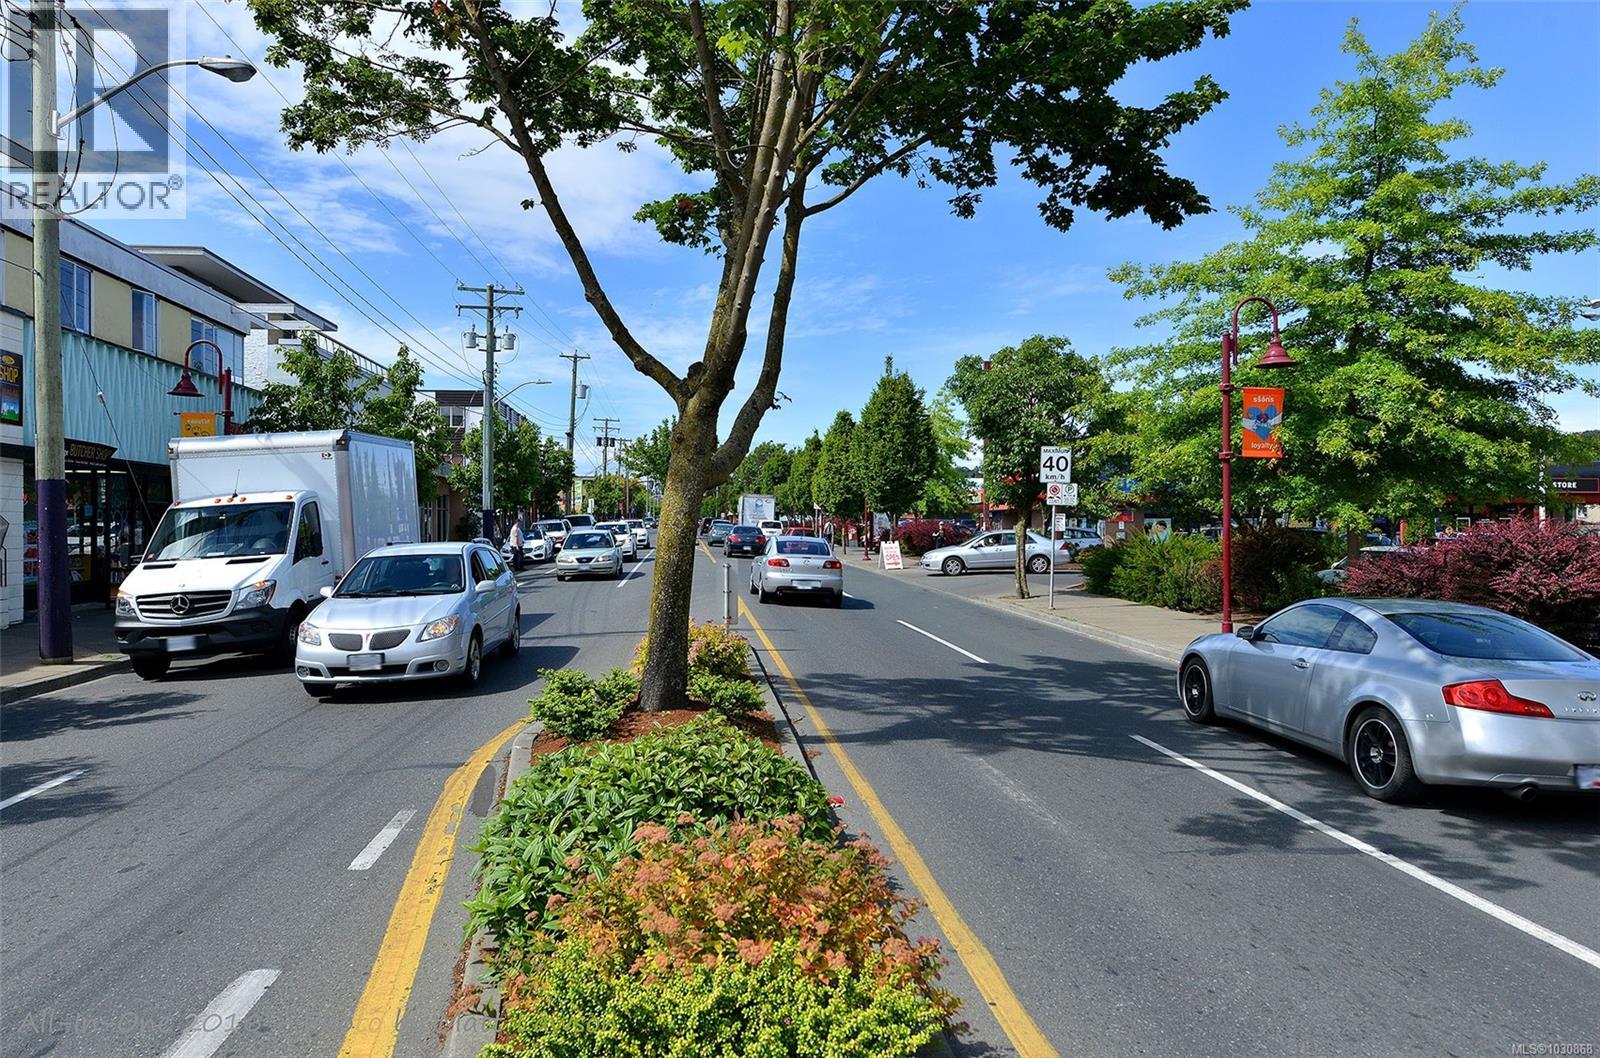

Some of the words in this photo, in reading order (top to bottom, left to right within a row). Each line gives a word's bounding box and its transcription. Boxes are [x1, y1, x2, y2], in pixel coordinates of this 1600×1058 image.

[69, 442, 96, 459] BUTCHER
[1251, 441, 1275, 450] loyalty
[1043, 455, 1069, 472] 40
[1552, 481, 1577, 489] STORE
